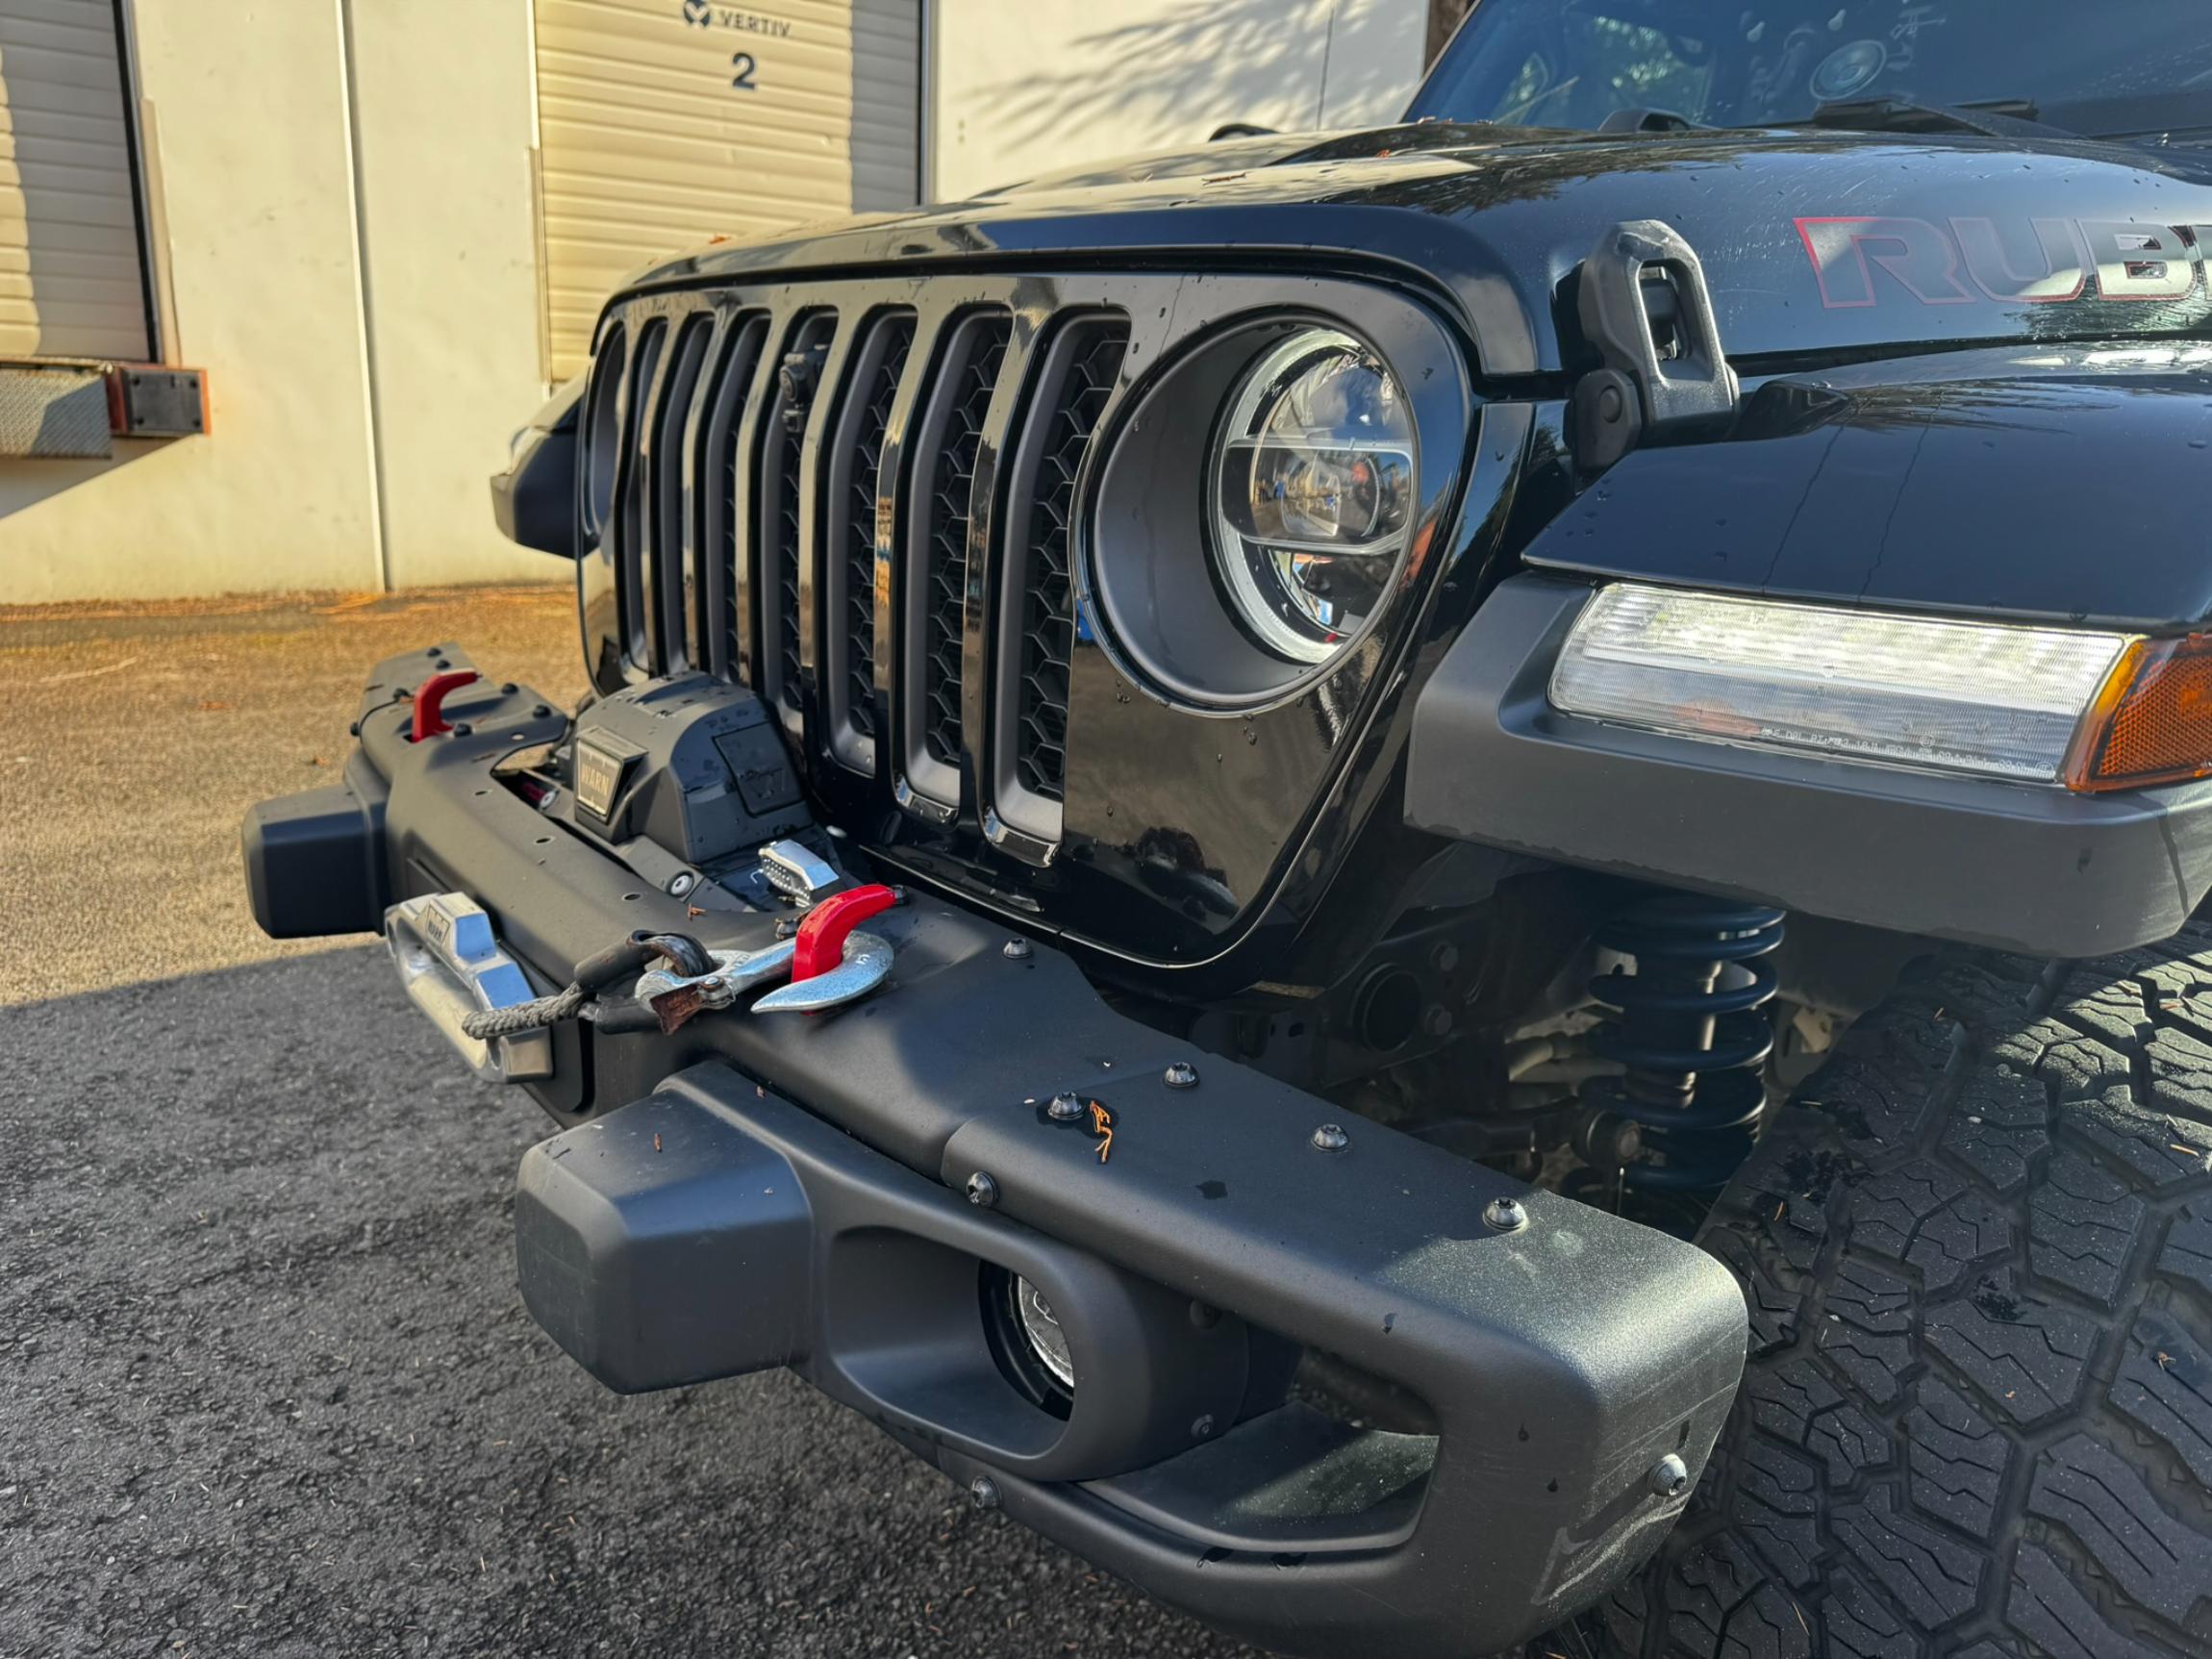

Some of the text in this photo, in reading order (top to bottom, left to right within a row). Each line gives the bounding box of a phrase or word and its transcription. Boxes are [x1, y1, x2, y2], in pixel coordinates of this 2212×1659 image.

[718, 9, 792, 38] VERTIV
[732, 52, 755, 90] 2
[581, 763, 611, 797] WARN
